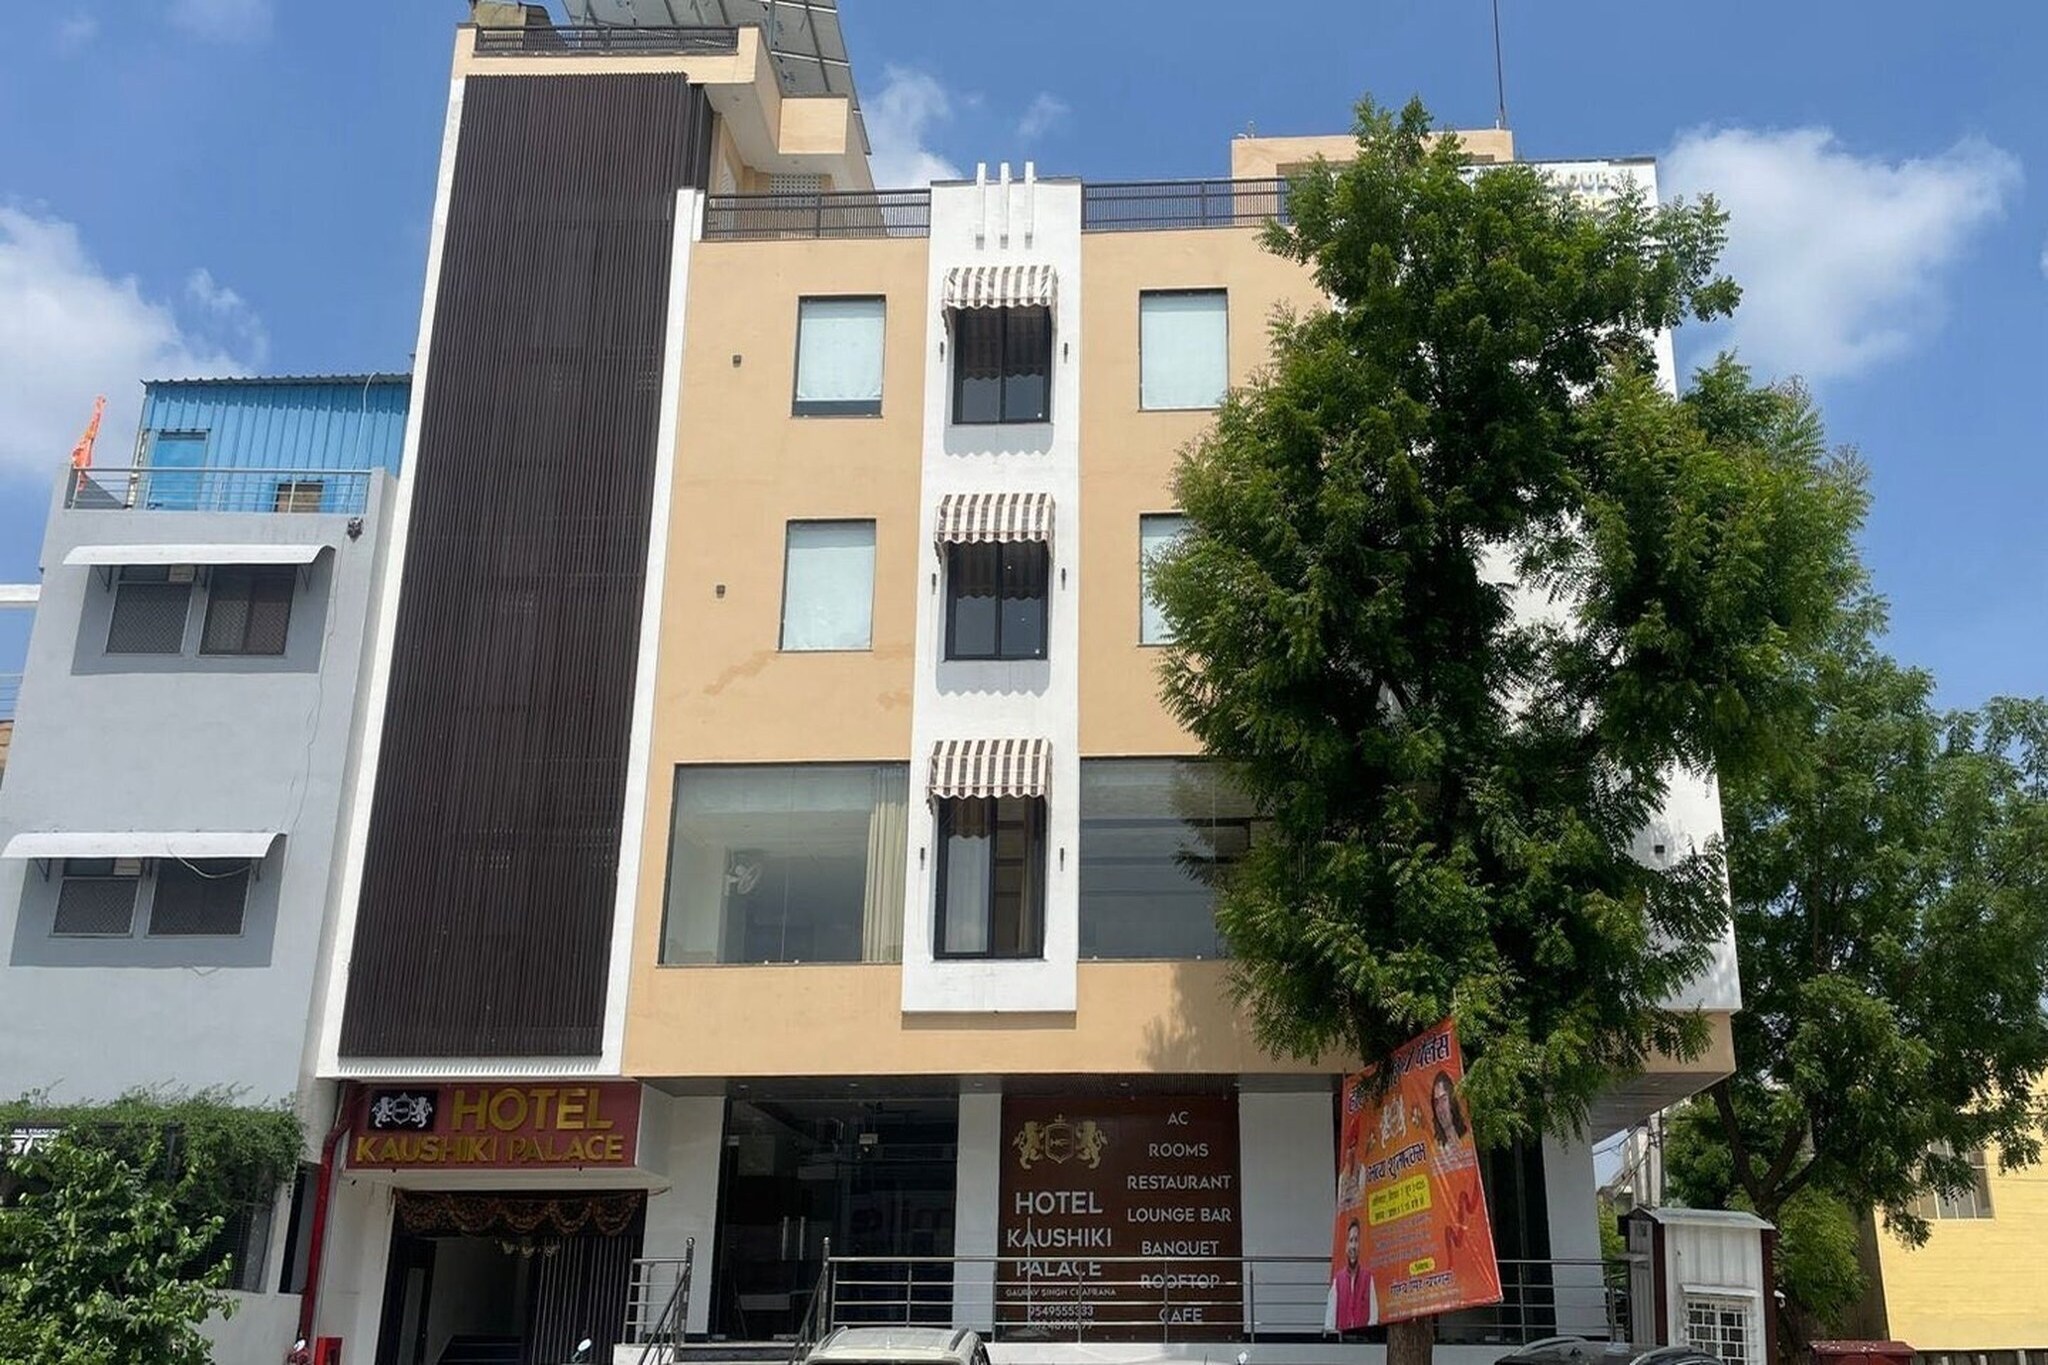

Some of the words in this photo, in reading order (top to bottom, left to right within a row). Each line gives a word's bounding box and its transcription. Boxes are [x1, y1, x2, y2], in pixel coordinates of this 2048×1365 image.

[452, 1088, 614, 1131] HOTEL
[1168, 1111, 1190, 1125] AC
[355, 1136, 497, 1162] KAUSHIKI
[507, 1135, 624, 1162] PALACE
[1149, 1143, 1209, 1157] ROOMS
[1127, 1175, 1231, 1190] RESTAURANT
[1015, 1191, 1103, 1214] HOTEL
[1127, 1208, 1195, 1222] LOUNGE
[1201, 1208, 1232, 1222] BAR
[1007, 1228, 1112, 1247] KAUSHIKI
[1141, 1241, 1219, 1256] BANQUET
[1016, 1258, 1102, 1276] PALACE
[1140, 1274, 1220, 1289] ROOFTOP
[1159, 1307, 1203, 1323] CAFE
